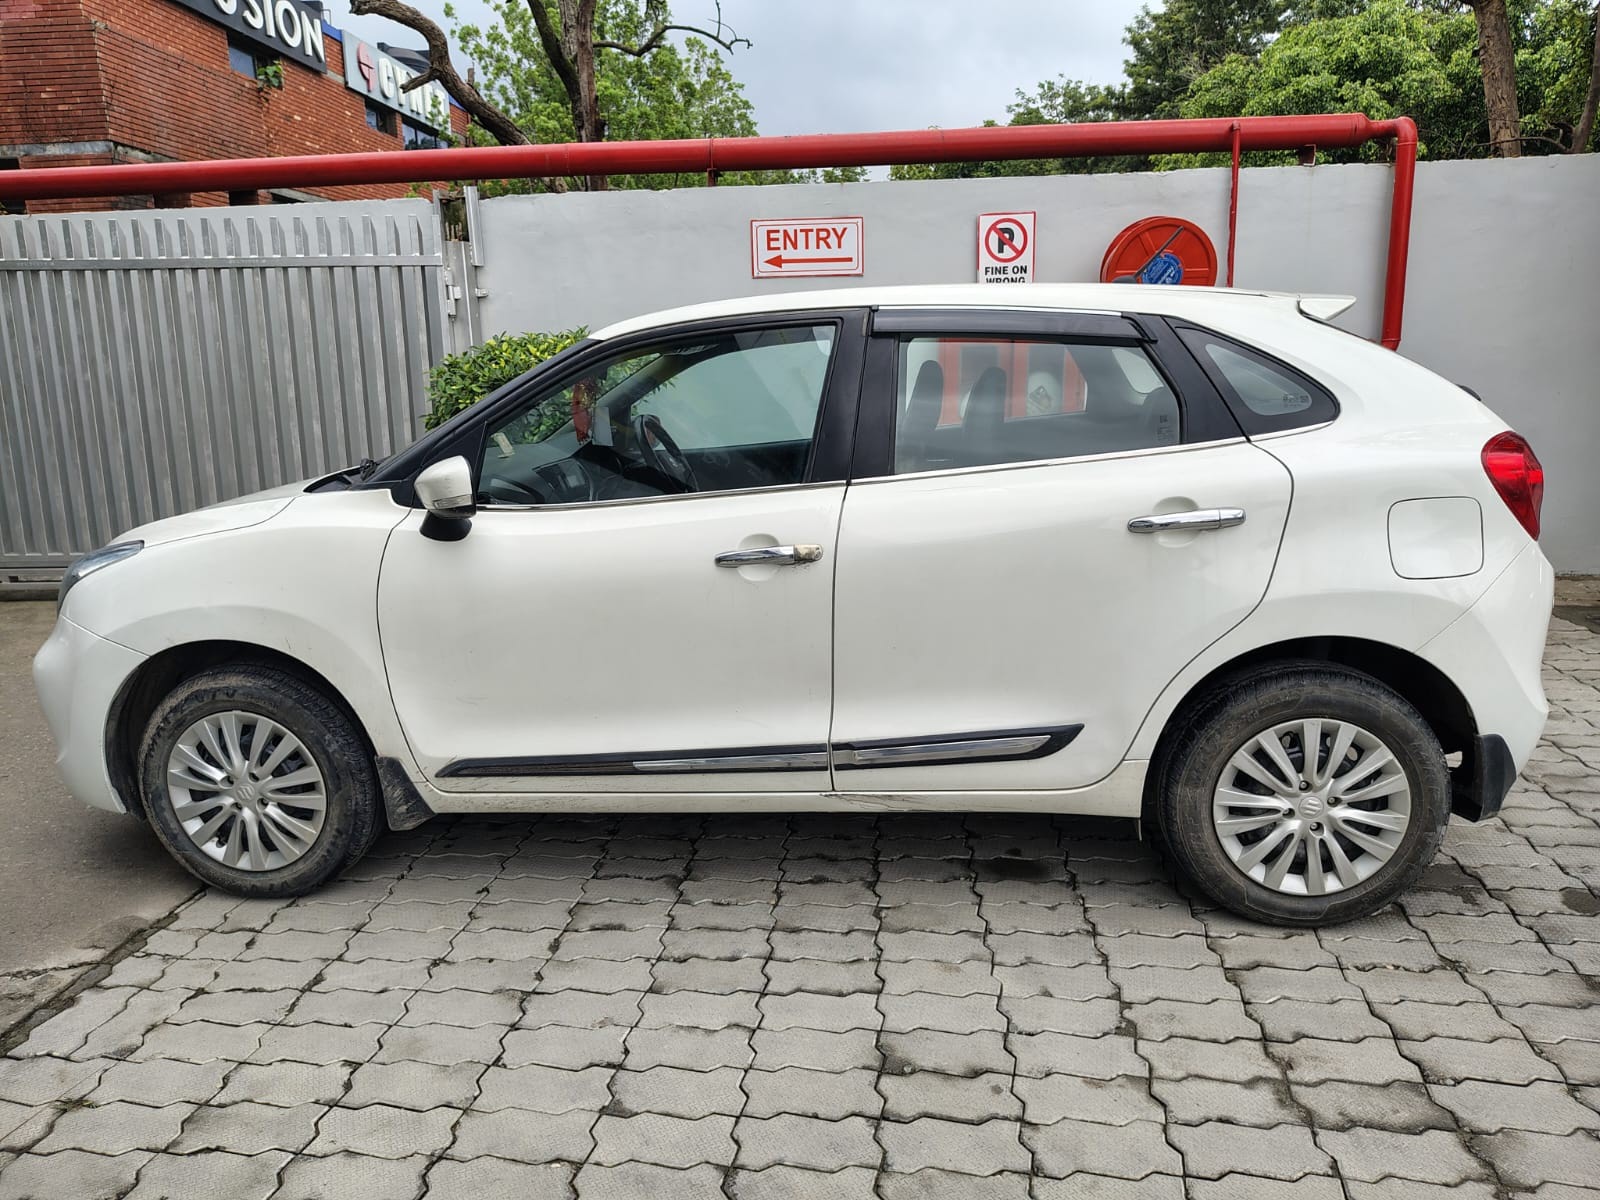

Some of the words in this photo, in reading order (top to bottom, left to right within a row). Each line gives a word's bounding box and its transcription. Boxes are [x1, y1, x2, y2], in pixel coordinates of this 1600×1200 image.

[766, 227, 848, 251] ENTRY
[998, 228, 1015, 253] P
[984, 266, 1009, 276] FINE
[1012, 265, 1028, 275] ON
